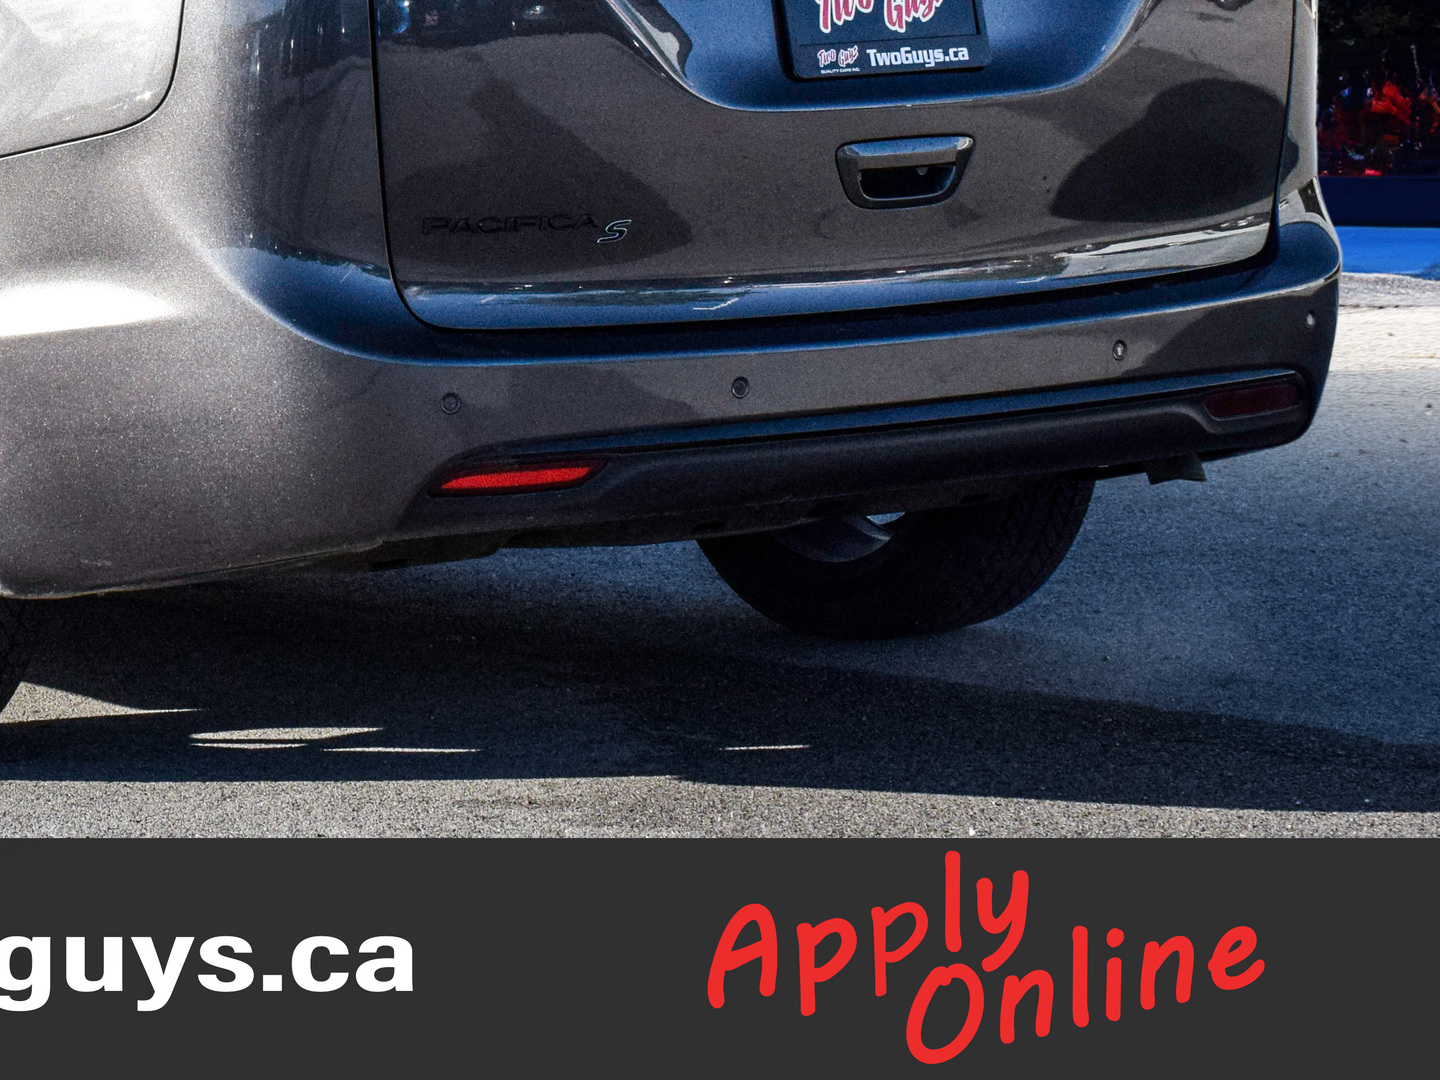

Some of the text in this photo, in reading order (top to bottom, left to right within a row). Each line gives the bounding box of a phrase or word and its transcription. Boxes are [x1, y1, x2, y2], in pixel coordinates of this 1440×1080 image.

[866, 46, 970, 68] TwoGuys.ca
[421, 212, 632, 243] PACIFICA S
